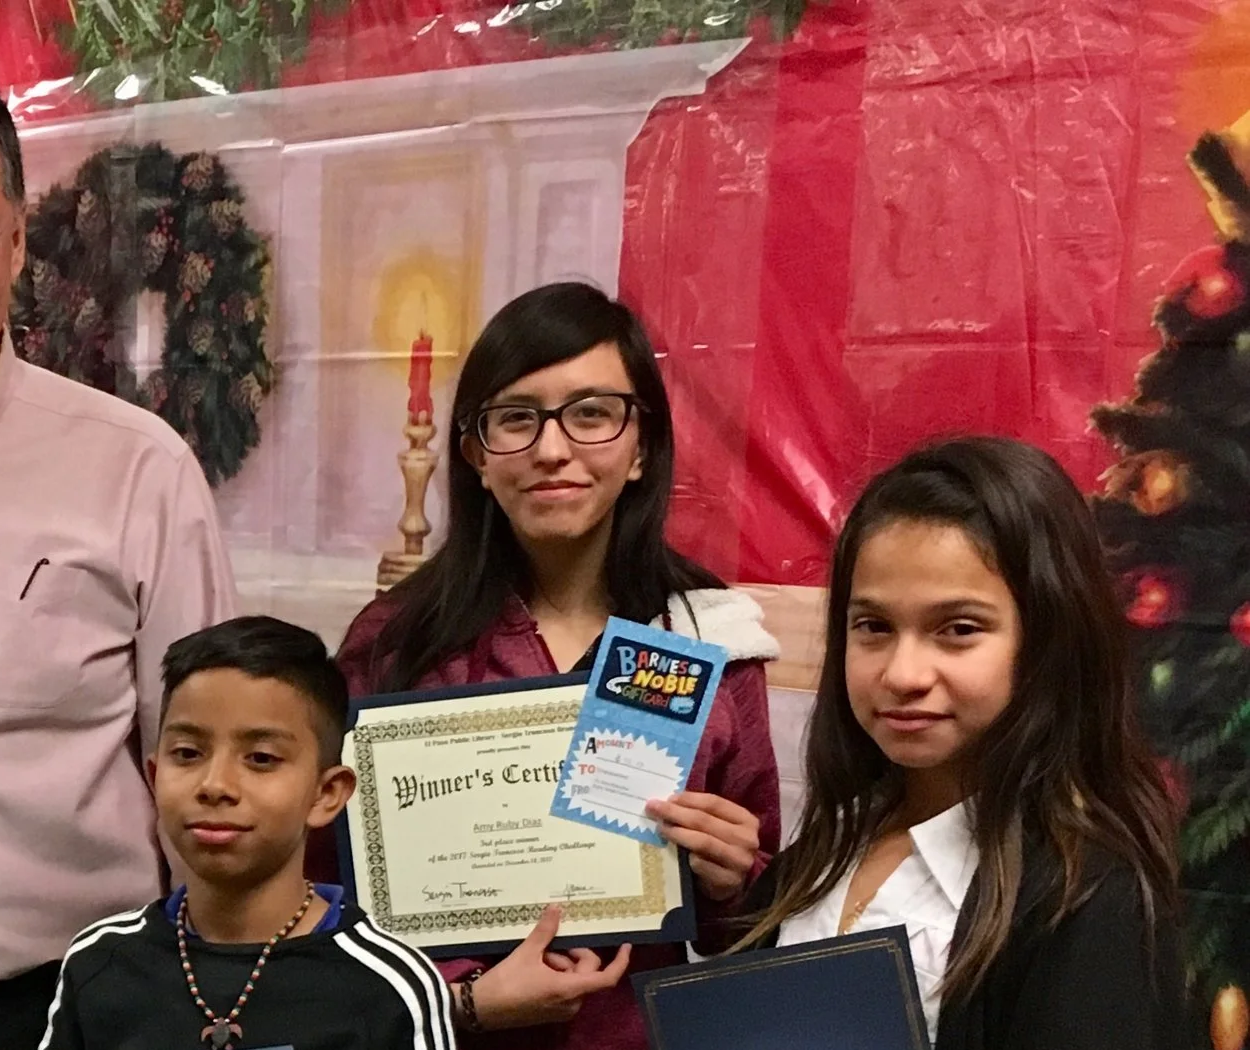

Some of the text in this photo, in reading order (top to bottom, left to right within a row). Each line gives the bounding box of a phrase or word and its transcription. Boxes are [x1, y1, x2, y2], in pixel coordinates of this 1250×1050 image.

[616, 645, 690, 675] BARNES
[632, 669, 699, 695] NOBLE
[622, 685, 648, 702] GIFT
[578, 764, 596, 775] TO
[392, 760, 565, 811] Winner's Certif
[473, 817, 543, 833] Amy Ruby Diaz
[437, 854, 448, 862] the
[559, 841, 596, 851] Challenge
